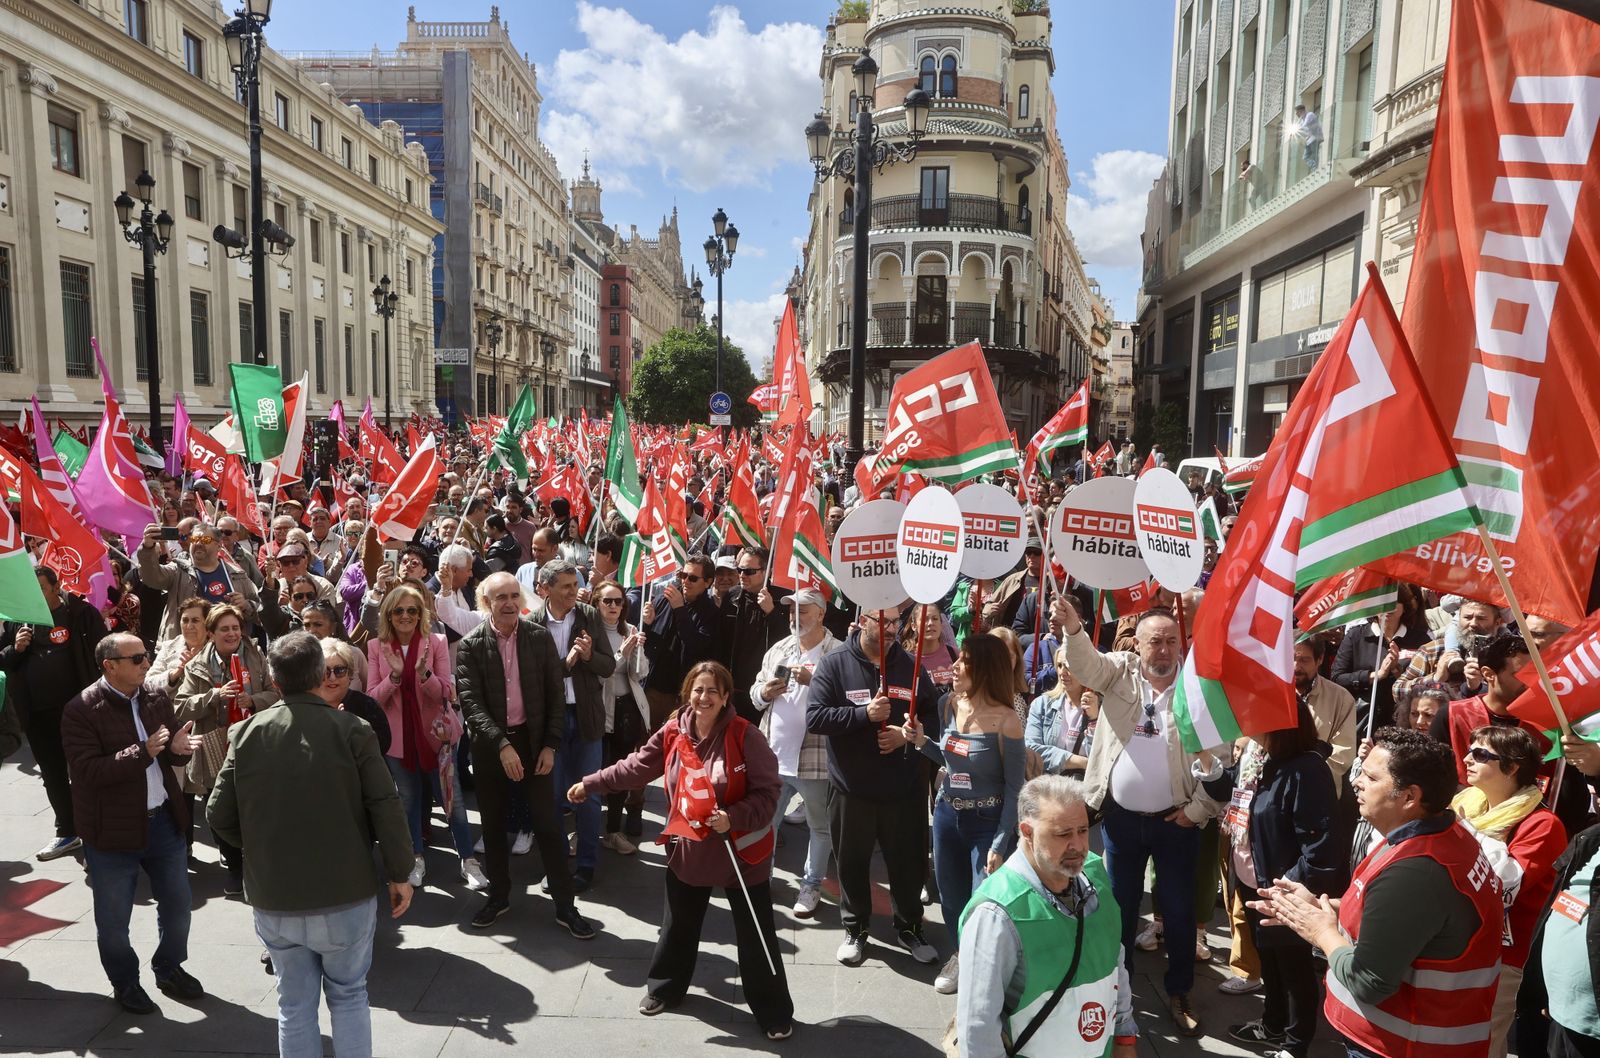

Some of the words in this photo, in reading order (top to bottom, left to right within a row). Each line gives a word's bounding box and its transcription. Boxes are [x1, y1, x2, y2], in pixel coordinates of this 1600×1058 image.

[963, 517, 996, 531] COO
[1067, 513, 1130, 534] CCOO
[1140, 510, 1175, 529] CCOO
[905, 526, 940, 544] CCOO
[964, 535, 1009, 552] ábitat
[844, 540, 896, 556] CCOO
[1147, 533, 1191, 558] hábitat
[907, 548, 948, 570] hábitat
[852, 560, 899, 578] hábit
[209, 583, 223, 592] UGT
[50, 629, 67, 638] UGT
[1466, 848, 1490, 892] CCO
[1081, 1007, 1103, 1028] UGT
